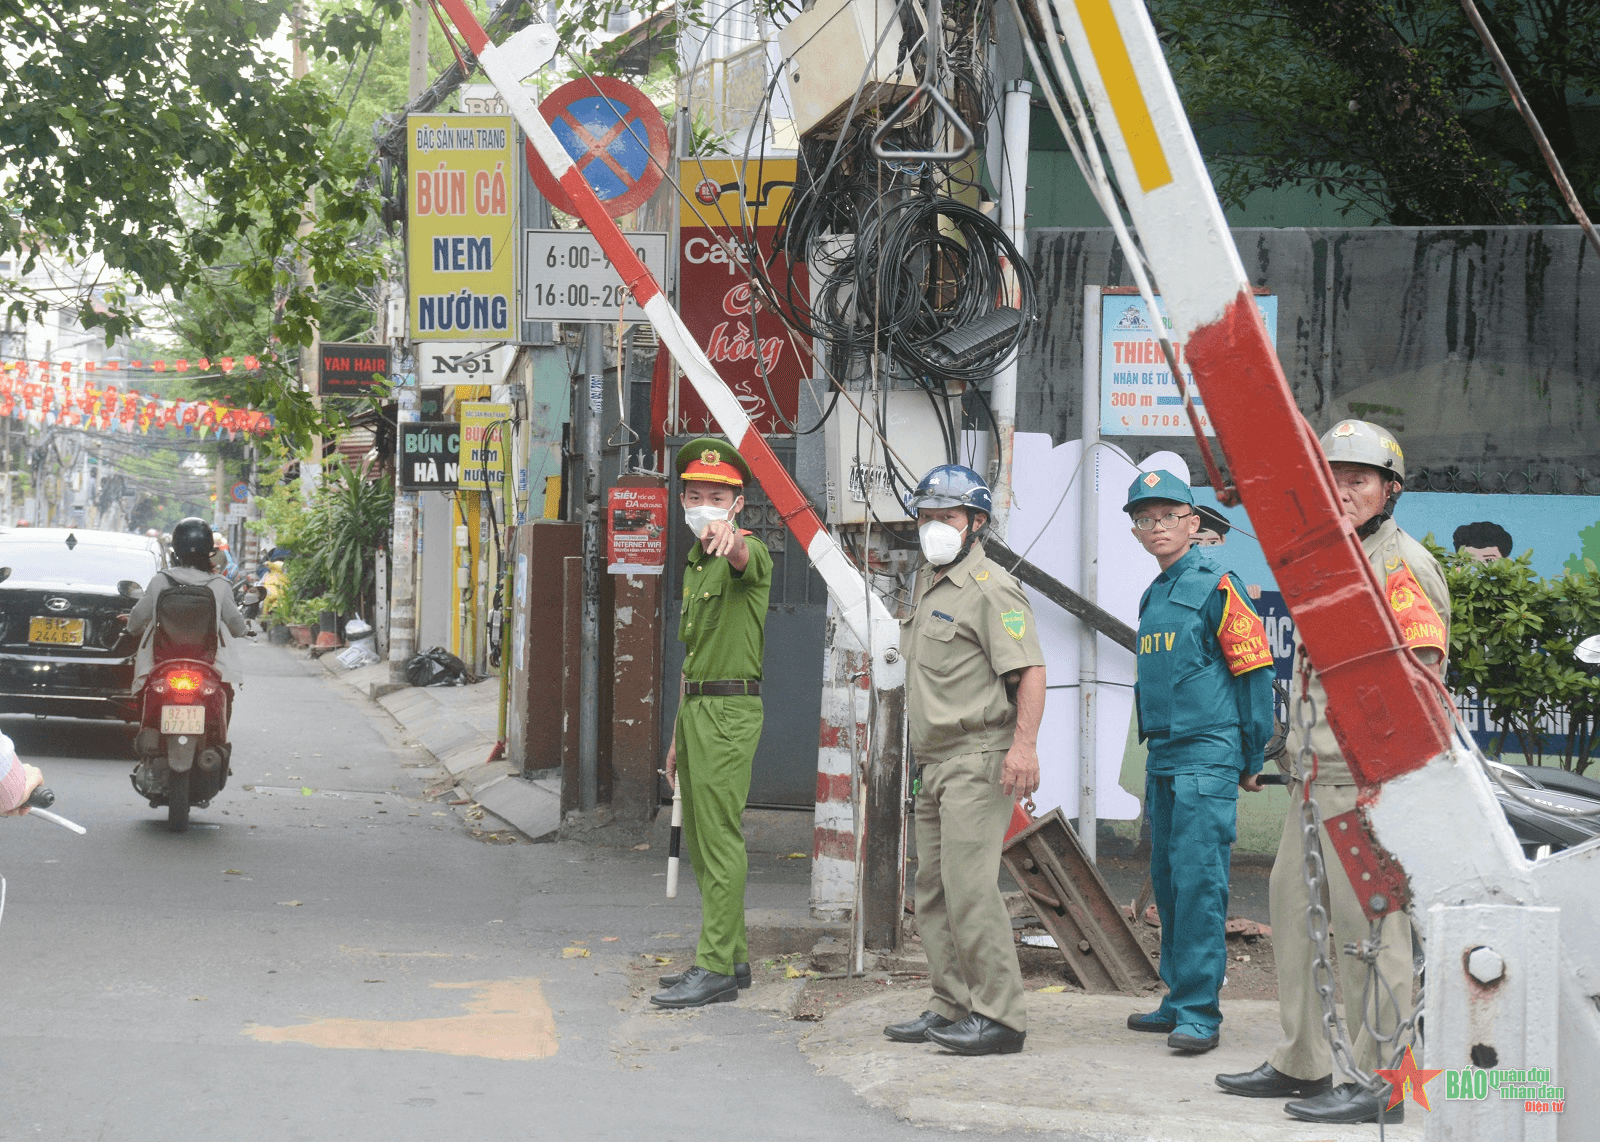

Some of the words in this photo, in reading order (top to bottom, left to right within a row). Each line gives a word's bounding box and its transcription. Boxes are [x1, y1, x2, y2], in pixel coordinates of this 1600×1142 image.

[417, 126, 434, 153] ĐẶC
[436, 123, 454, 149] SẢN
[456, 129, 474, 149] NHA
[476, 129, 505, 149] TRANG
[416, 162, 466, 215] BÚN
[475, 162, 506, 215] CÁ
[433, 237, 492, 271] NEM
[419, 289, 507, 330] NƯỚNG
[324, 357, 350, 371] YAN
[354, 358, 386, 372] HAIR
[432, 351, 493, 378] Nội
[1111, 392, 1136, 406] 300
[1140, 395, 1153, 406] m
[405, 429, 443, 453] BÚN
[414, 457, 439, 482] HÀ
[1406, 622, 1429, 641] DÂN
